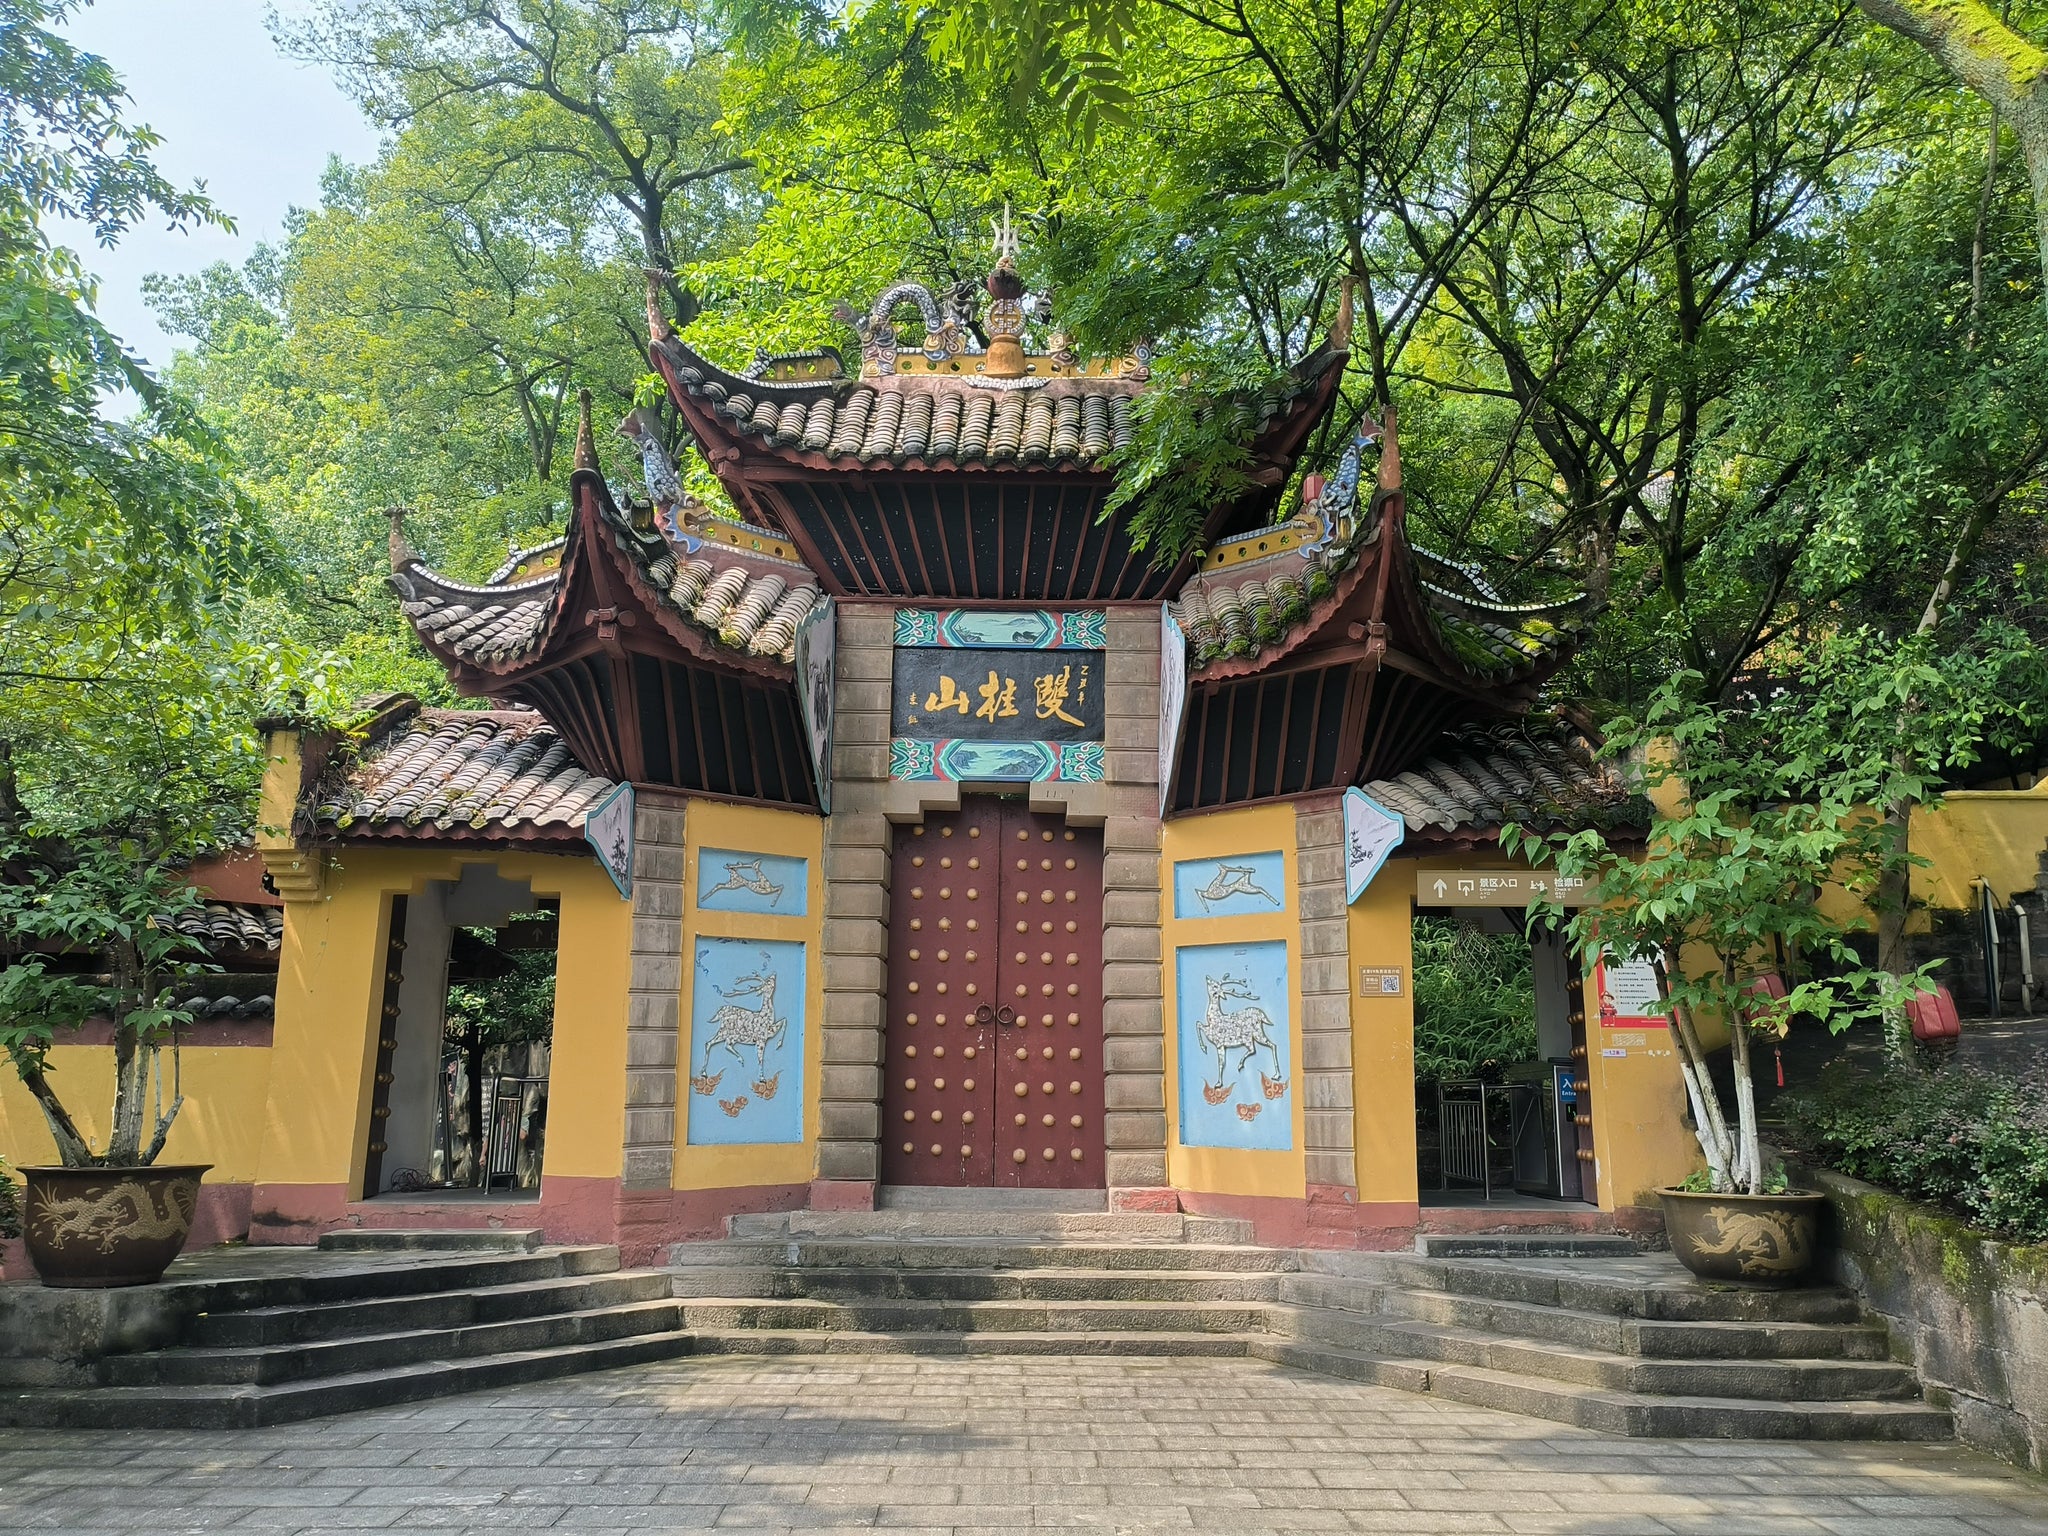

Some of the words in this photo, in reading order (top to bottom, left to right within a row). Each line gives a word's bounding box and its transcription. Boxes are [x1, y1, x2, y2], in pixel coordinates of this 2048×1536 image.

[1479, 878, 1518, 888] 景区入口
[1554, 877, 1584, 888] 检票口
